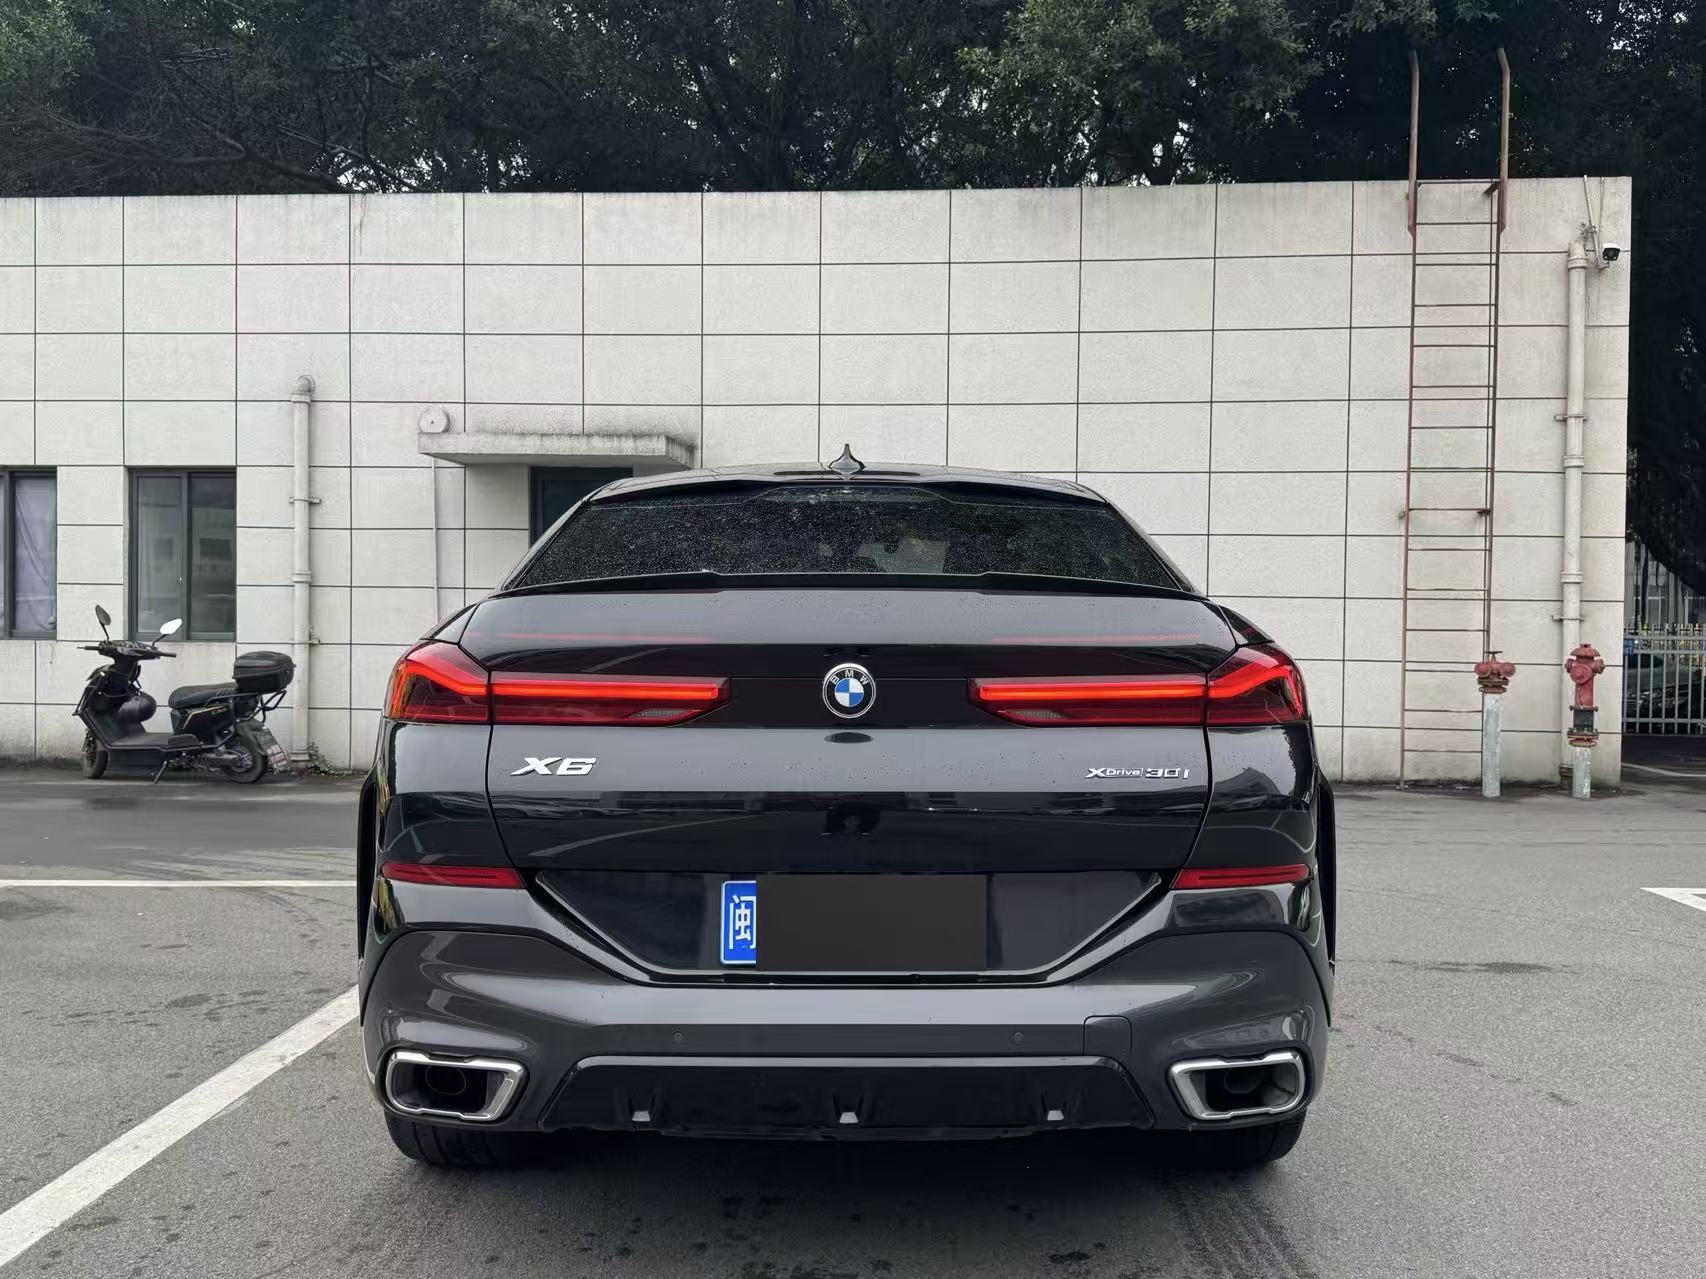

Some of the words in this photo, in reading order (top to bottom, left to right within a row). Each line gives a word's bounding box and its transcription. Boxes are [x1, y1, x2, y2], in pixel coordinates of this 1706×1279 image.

[830, 669, 870, 685] BMW
[510, 757, 597, 776] X6
[729, 894, 757, 950] 闽
